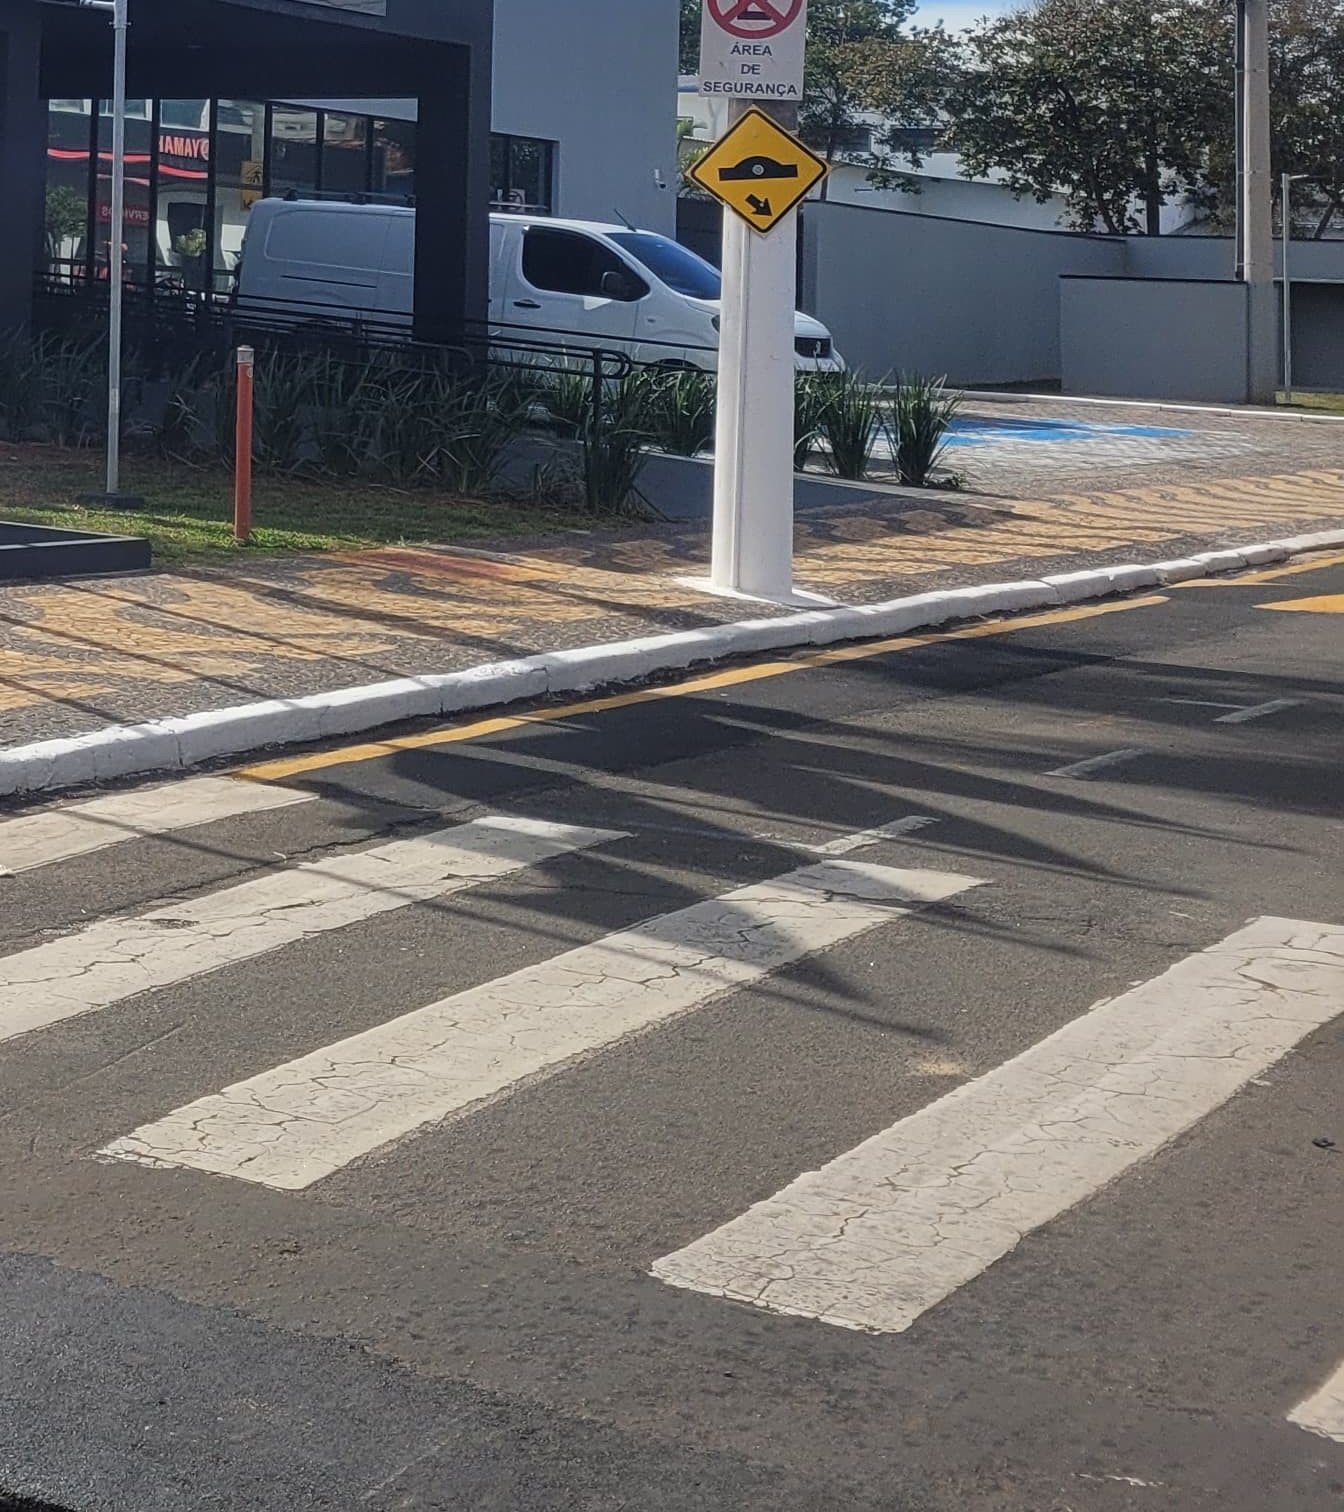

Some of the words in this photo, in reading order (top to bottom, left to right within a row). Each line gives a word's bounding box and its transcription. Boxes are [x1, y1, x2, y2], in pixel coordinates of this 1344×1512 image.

[730, 41, 773, 57] ÁREA
[740, 63, 761, 75] DE
[703, 81, 797, 97] SEGURANÇA
